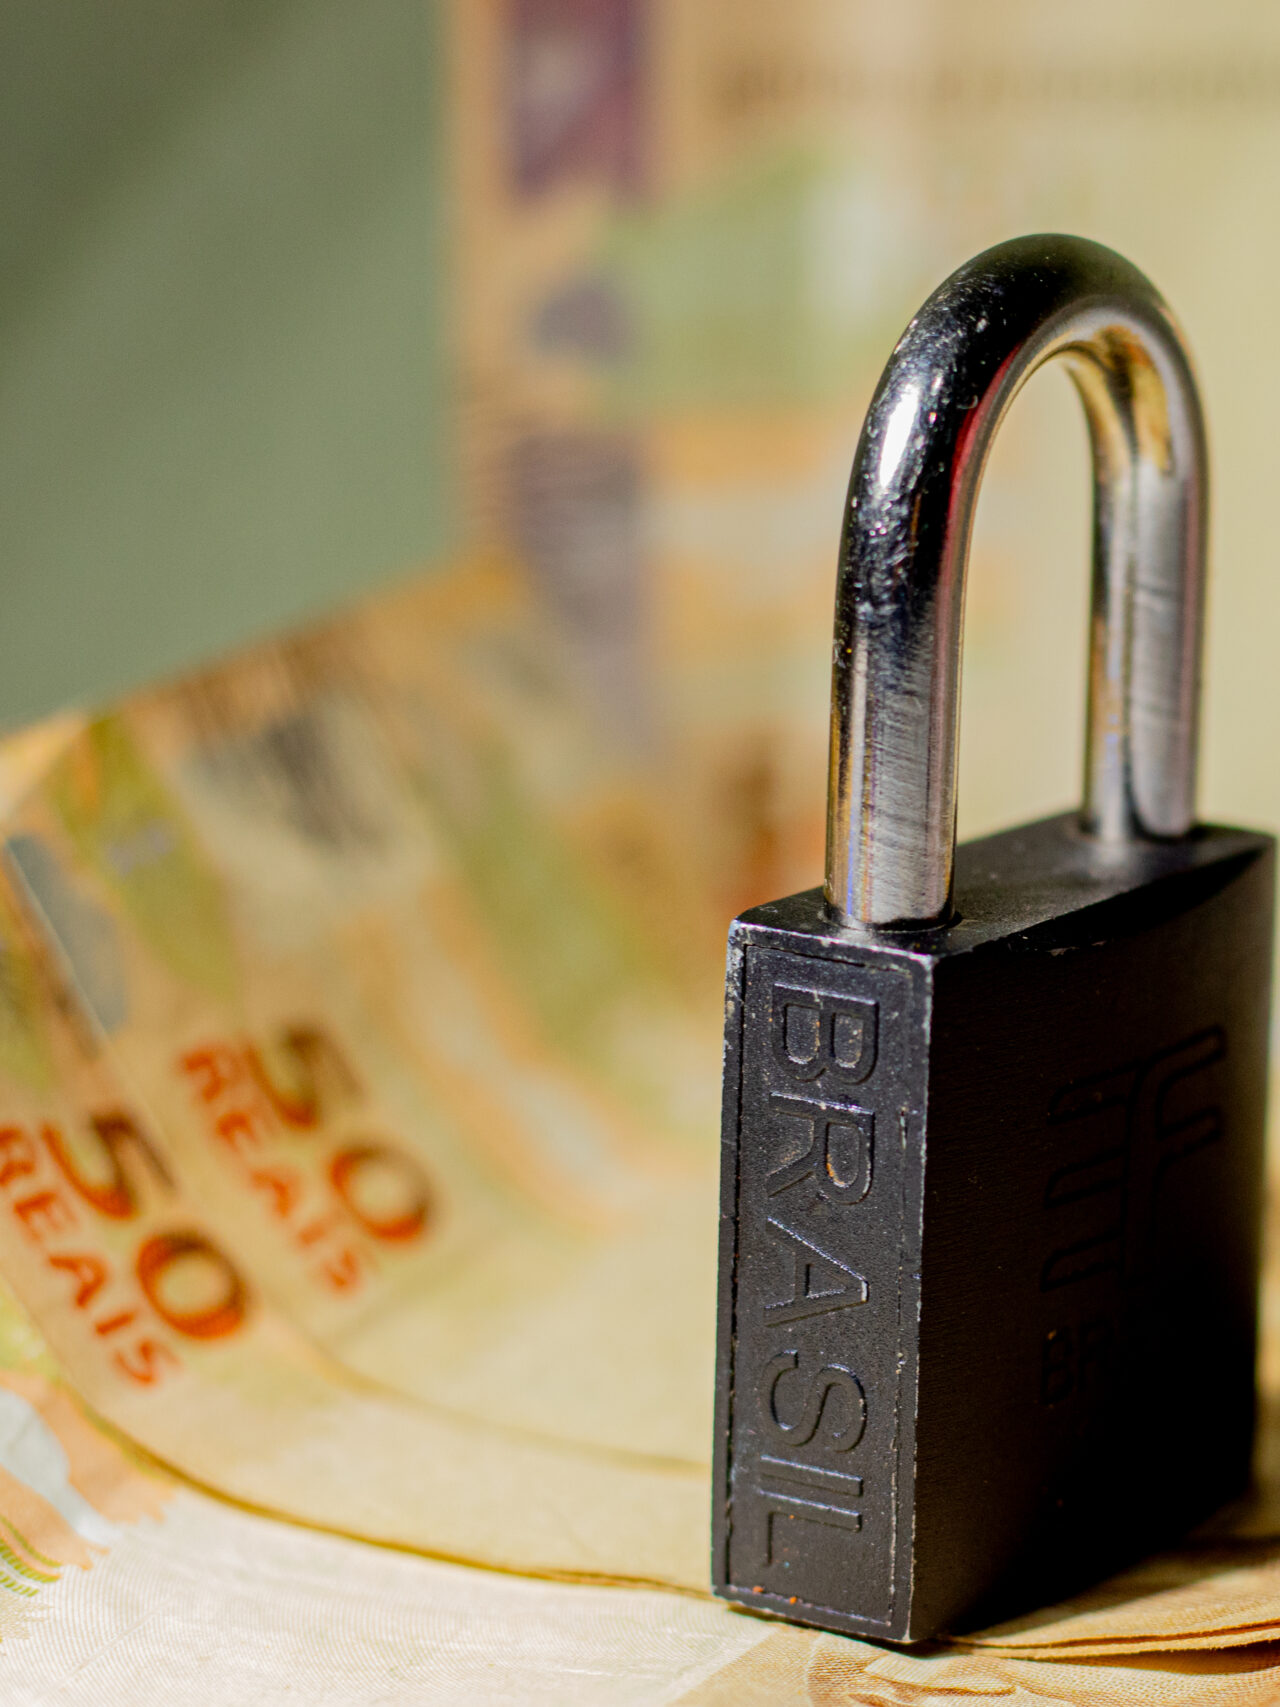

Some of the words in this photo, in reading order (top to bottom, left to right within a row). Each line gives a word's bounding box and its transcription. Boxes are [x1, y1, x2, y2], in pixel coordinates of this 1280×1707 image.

[0, 1124, 182, 1388] REAIS
[42, 1107, 250, 1342] 50
[178, 1040, 372, 1296] REAIS
[246, 1020, 442, 1246] 50
[758, 982, 879, 1568] BRASIL
